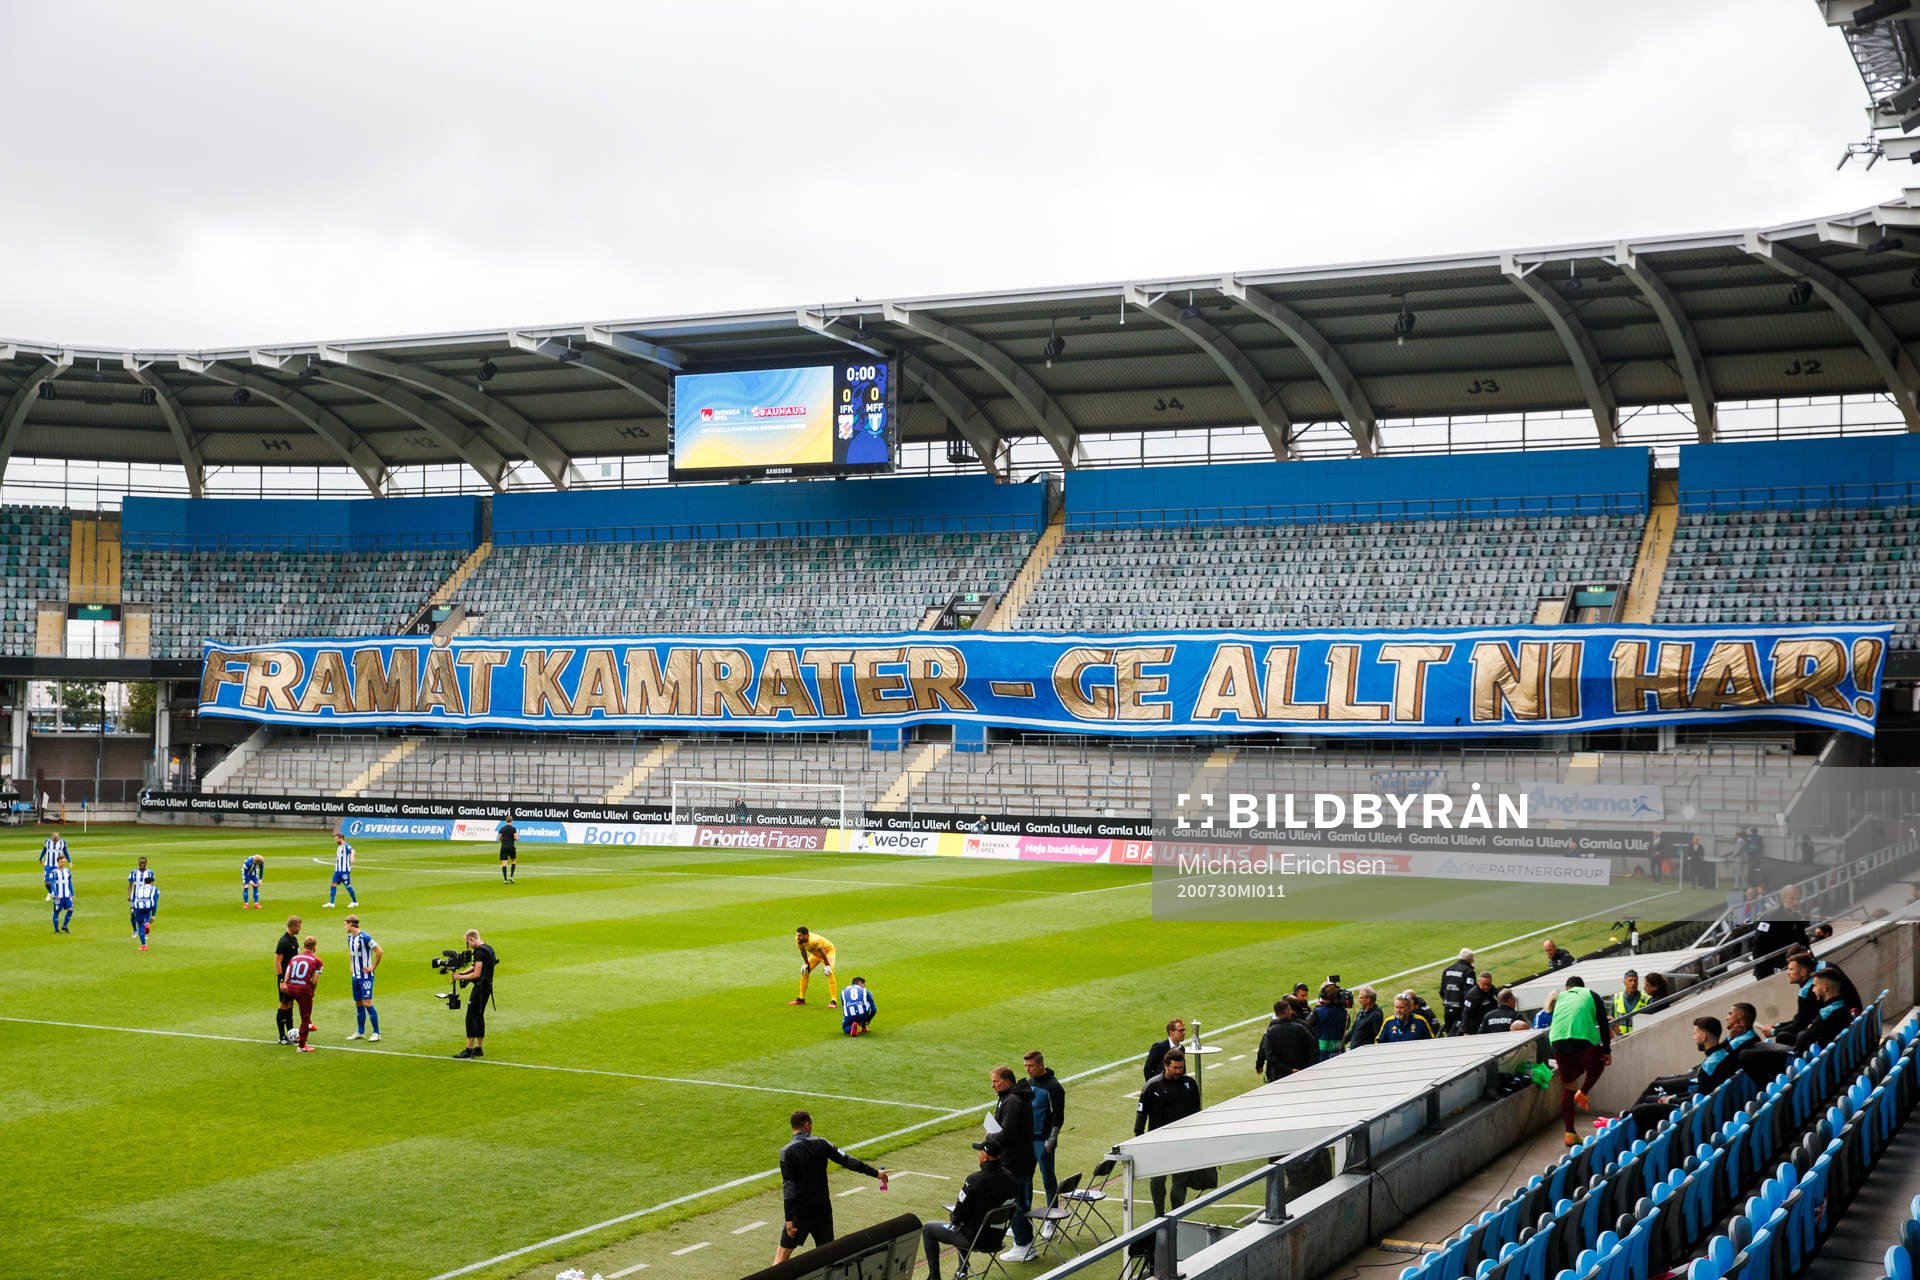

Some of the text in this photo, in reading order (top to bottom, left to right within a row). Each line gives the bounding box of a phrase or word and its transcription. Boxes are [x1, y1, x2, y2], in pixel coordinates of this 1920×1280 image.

[1784, 359, 1824, 375] J2
[846, 366, 876, 381] 0:00
[1467, 379, 1500, 393] J3
[843, 388, 851, 402] 0
[871, 387, 879, 401] 0
[840, 404, 854, 413] IFK
[866, 402, 884, 412] MFF
[1154, 398, 1184, 411] J4
[760, 407, 805, 417] BAUHAUS
[616, 426, 650, 439] H3
[261, 438, 293, 450] H1
[943, 615, 954, 627] H4
[417, 623, 430, 634] H2
[201, 634, 511, 715] FRAMÅT
[521, 646, 975, 717] KAMRATER
[1052, 644, 1176, 722] GE
[1191, 643, 1454, 724] ALLT
[1469, 640, 1584, 722] NI
[1610, 637, 1884, 719] HAR!
[141, 798, 188, 807] Gamla Ullevi
[191, 799, 239, 809] Gamla Ullevi
[242, 800, 291, 810] Gamla Ullevi
[294, 801, 344, 812] Gamla Ullevi
[347, 803, 398, 813] Gamla Ullevi
[401, 804, 454, 815] Gamla Ullevi
[458, 806, 511, 817] Gamla Ullevi
[515, 807, 569, 818] Gamla Ullevi
[573, 809, 628, 820] Gamla Ullevi
[633, 811, 689, 822] Gamla Ulevi
[694, 813, 752, 824] Gamla Uli
[757, 815, 816, 825] Gamla Ullevi
[364, 823, 445, 834] SVENSKA CUPEN
[855, 818, 883, 828] Ullevi
[922, 819, 951, 830] Ullevi
[991, 821, 1020, 832] Ullevi
[1026, 822, 1092, 834] Gamla Ullevi
[584, 826, 679, 845] Borohus
[1098, 824, 1166, 836] Gamla Ullevi
[1172, 826, 1242, 838] Gamla Ullevi
[1249, 828, 1321, 841] Gamla Ullevi
[698, 828, 817, 849] Prioritet Finans
[875, 833, 928, 848] weber
[1327, 830, 1402, 843] Gamla Ullevi
[1409, 833, 1486, 846] Gamla Ullevi
[1492, 835, 1572, 848] Gamla Ullevi
[1579, 837, 1650, 850] Gamla Ulle
[1126, 843, 1250, 861] BAUHAUS
[290, 960, 309, 979] 10
